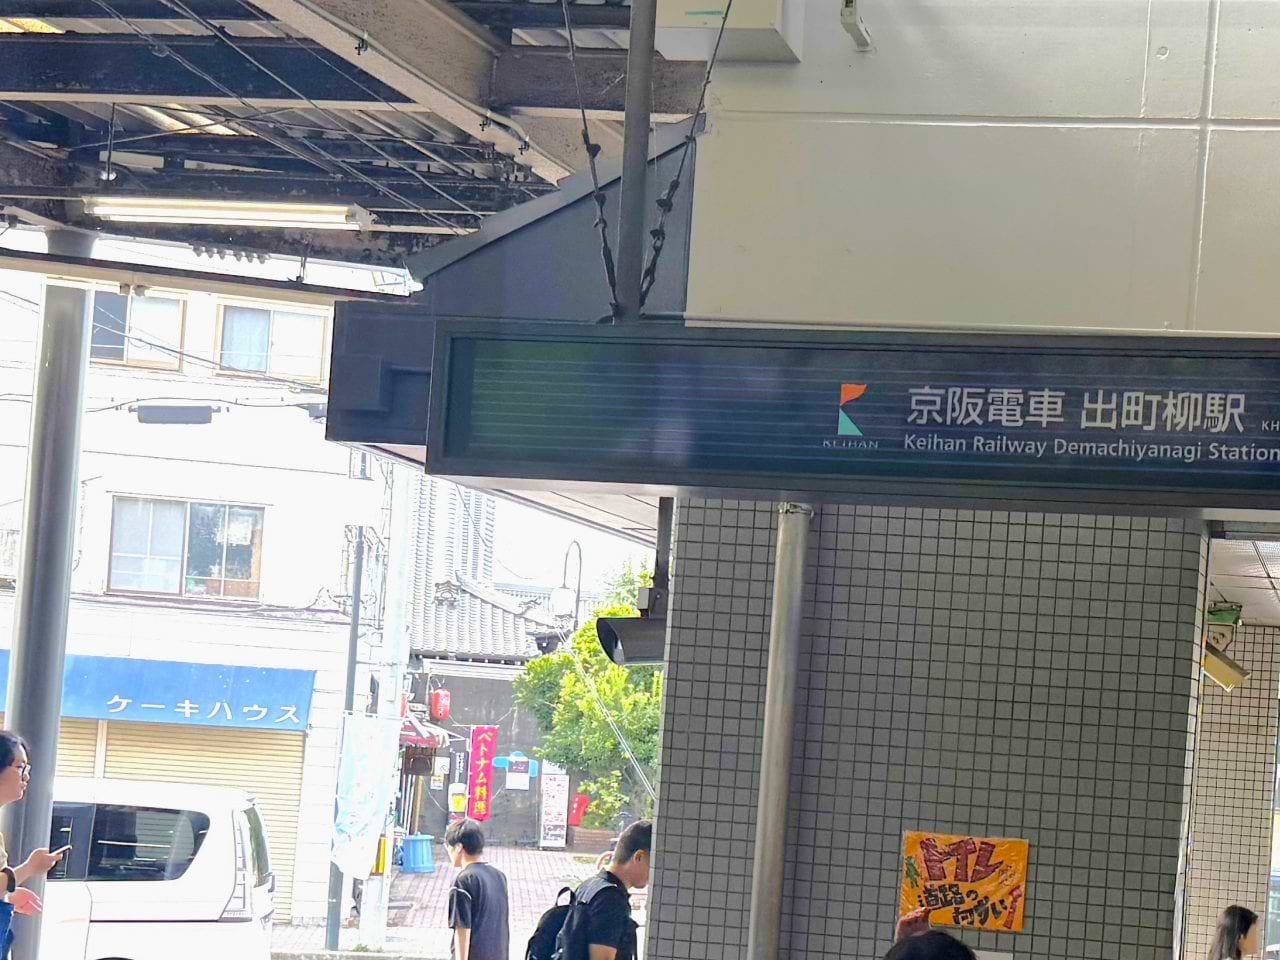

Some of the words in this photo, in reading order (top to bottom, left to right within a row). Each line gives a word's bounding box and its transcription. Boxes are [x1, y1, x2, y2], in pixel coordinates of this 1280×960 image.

[906, 385, 1066, 428] 京阪電車
[1080, 389, 1246, 433] 出町柳駅
[1261, 420, 1280, 432] KH
[904, 433, 966, 451] Keihan
[974, 435, 1047, 458] Railway
[1054, 439, 1202, 463] Demachiyanagi
[1208, 442, 1280, 462] Station
[106, 694, 300, 724] ケーキハウス
